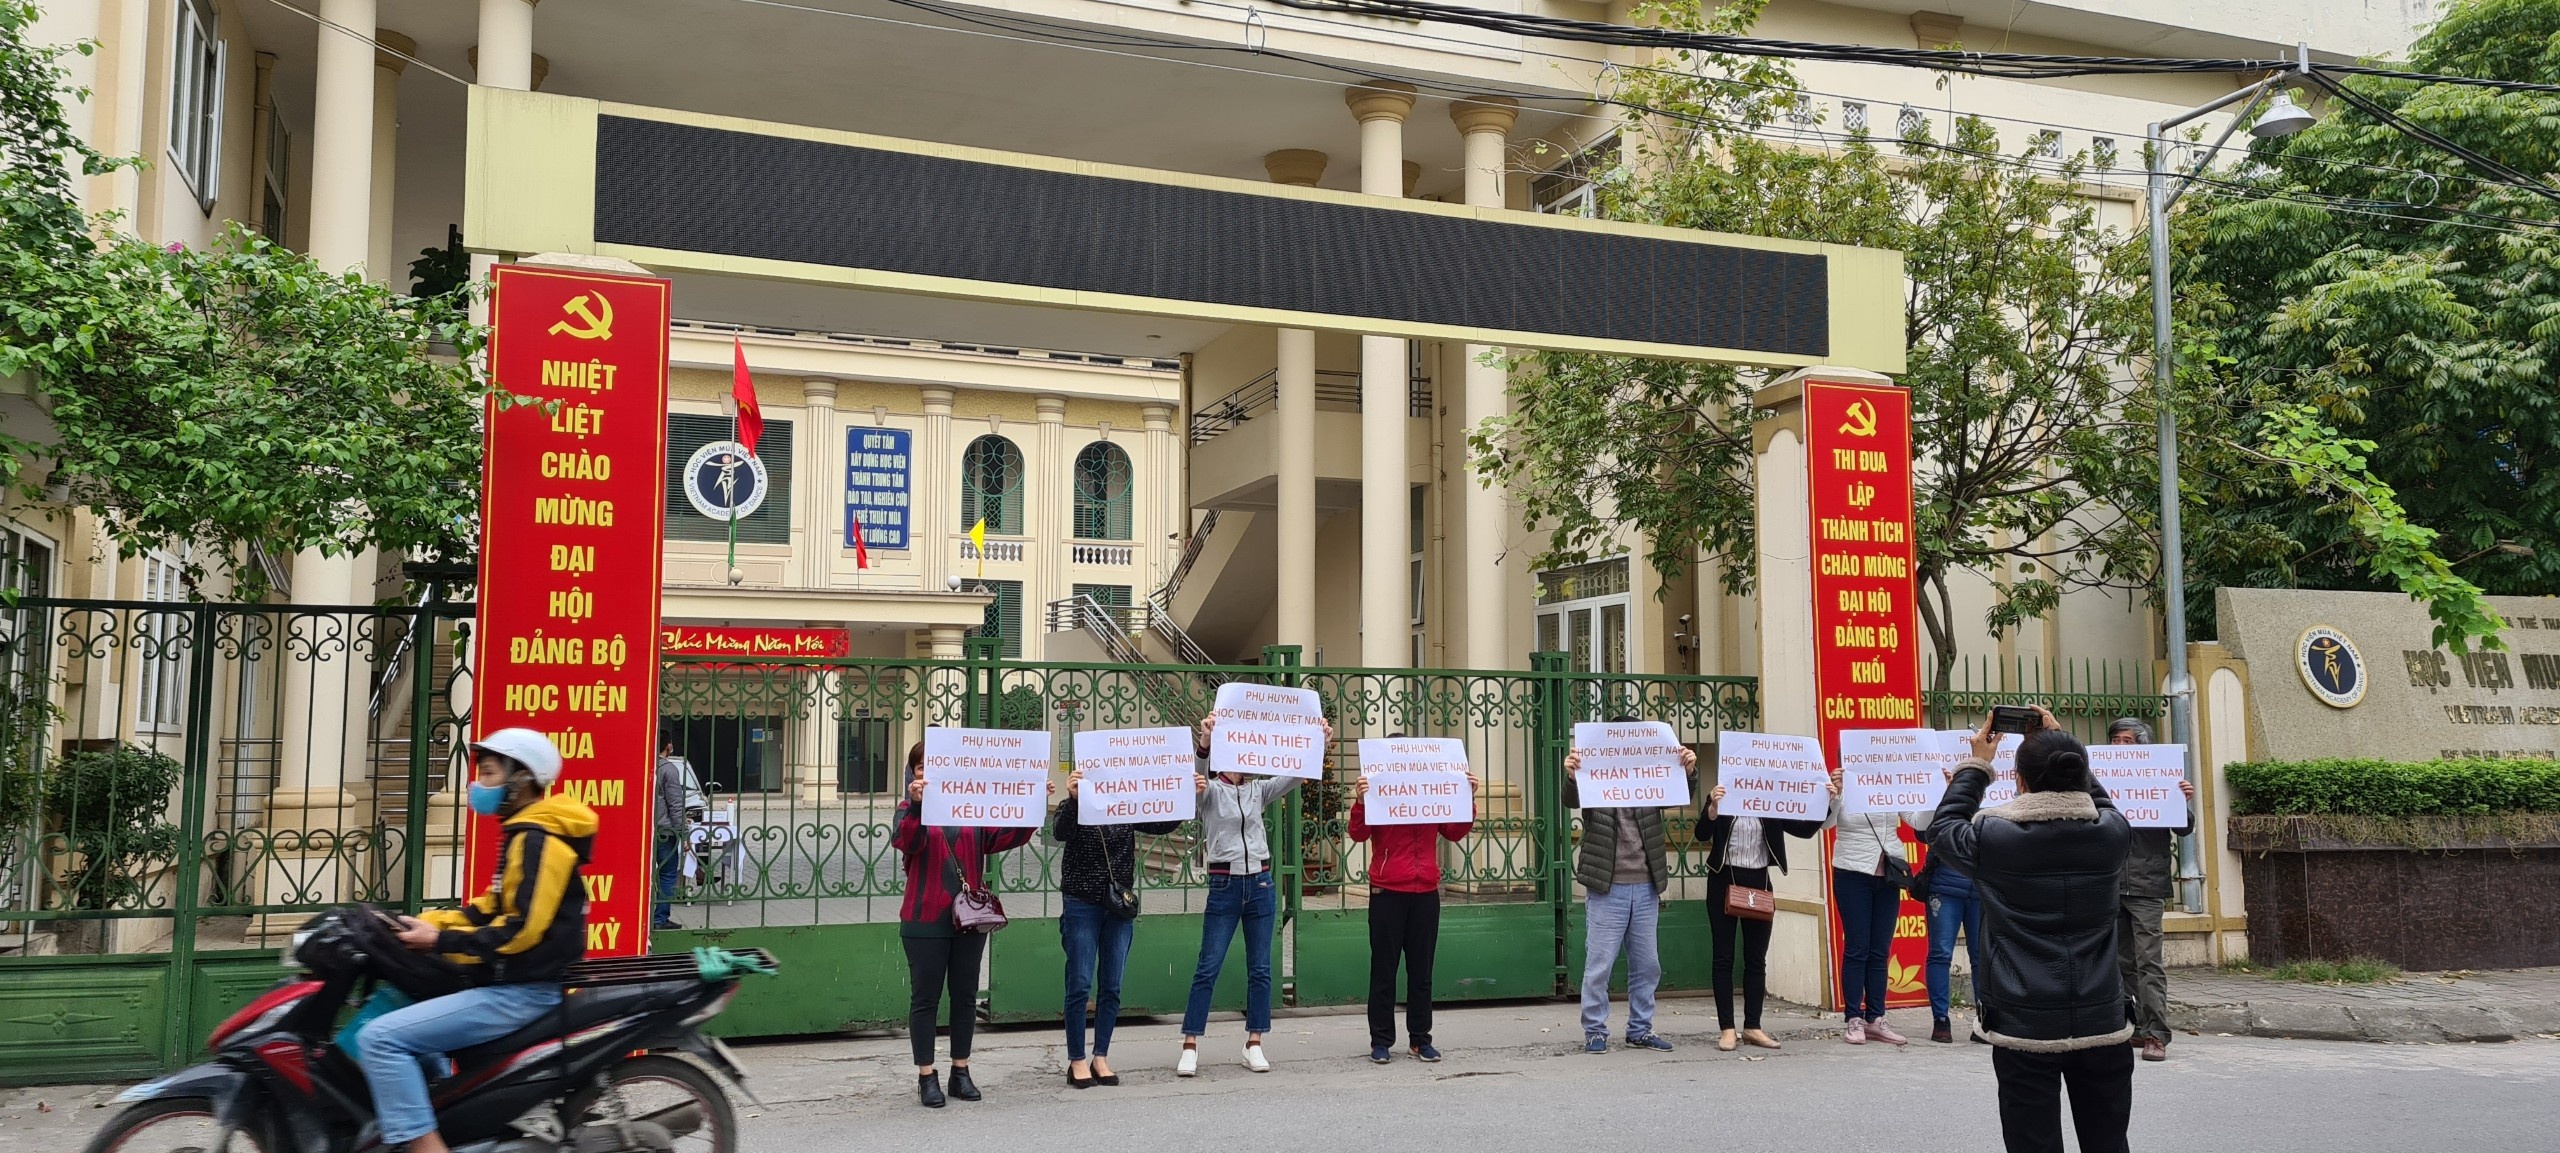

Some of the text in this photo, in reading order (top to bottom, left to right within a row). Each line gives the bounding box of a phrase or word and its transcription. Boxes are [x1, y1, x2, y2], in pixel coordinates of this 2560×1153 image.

[541, 358, 618, 395] NHIỆT
[551, 403, 605, 440] LIỆT
[541, 448, 611, 481] CHÀO
[751, 460, 763, 476] NAM
[1833, 448, 1888, 473] THI ĐUA
[872, 472, 891, 487] TRUNG
[689, 484, 708, 509] VIETNAM
[741, 505, 749, 513] OF
[748, 486, 763, 507] DANCE
[1848, 481, 1875, 511] LẬP
[534, 493, 614, 527] MỪNG
[1821, 514, 1904, 543] THÀNH TÍCH
[550, 544, 595, 577] ĐẠI
[1821, 550, 1907, 578] CHÀO MỪNG
[548, 586, 593, 624] HỘI
[1839, 586, 1892, 619] ĐẠI HỘI
[661, 628, 825, 656] Chúc Mừng Năm Mới
[1835, 619, 1899, 654] ĐẢNG BỘ
[510, 629, 627, 671] ĐẢNG BỘ
[1852, 655, 1886, 684] KHỐI
[2402, 650, 2451, 694] HỌC
[505, 680, 627, 718] HỌC VIỆN
[1245, 691, 1299, 704] PHỤ HUYNH
[1825, 693, 1915, 720] CÁC TRƯỜNG
[1237, 709, 1258, 722] VIỆN
[1261, 710, 1280, 723] MÚA
[1282, 714, 1302, 726] VIỆT
[2444, 705, 2515, 725] VIETNAM
[962, 736, 1022, 749] PHỤ HUYNH
[1109, 735, 1166, 749] PHỤ HUYNH
[1607, 728, 1658, 740] PHỤ HUYNH
[1870, 735, 1917, 748] PHỤ HUYNH
[1391, 744, 1440, 755] PHỤ HUYNH
[1600, 746, 1620, 759] VIỆN
[1623, 745, 1642, 756] MÚA
[1644, 746, 1664, 758] VIỆT
[1752, 740, 1804, 752] PHỤ HUYNH
[927, 756, 950, 769] HỌC
[954, 756, 976, 770] VIỆN
[980, 755, 1002, 768] MÚA
[1005, 758, 1027, 771] VIỆT
[1078, 753, 1194, 771] HỌC VIỆN MÚA VIỆT NAM
[1237, 751, 1302, 770] KÊU CỨU
[1721, 756, 1742, 768] HỌC
[1745, 757, 1766, 770] VIỆN
[1769, 758, 1788, 769] MÚA
[1790, 760, 1809, 772] VIỆT
[1843, 754, 1863, 766] HỌC
[1864, 753, 1883, 766] VIỆN
[1885, 752, 1903, 763] MÚA
[1904, 752, 1923, 764] VIỆT
[1924, 752, 1941, 763] NAM
[2092, 751, 2150, 762] PHỤ HUYNH
[1363, 760, 1468, 775] HỌC VIỆN MÚA VIỆT NAM
[2111, 766, 2133, 777] MÚA
[2135, 768, 2158, 779] VIỆT
[2161, 768, 2183, 777] NAM
[564, 779, 624, 806] NAM
[1603, 785, 1664, 800] KÊU CỨU
[1868, 790, 1926, 806] KÊU CỨU
[952, 803, 1024, 819] KÊU CỨU
[1107, 798, 1174, 816] KÊU CỨU
[1389, 802, 1452, 818] KÊU CỨU
[1743, 797, 1807, 814] KÊU CỨU
[2125, 806, 2159, 821] CỨU
[587, 916, 621, 950] KỲ
